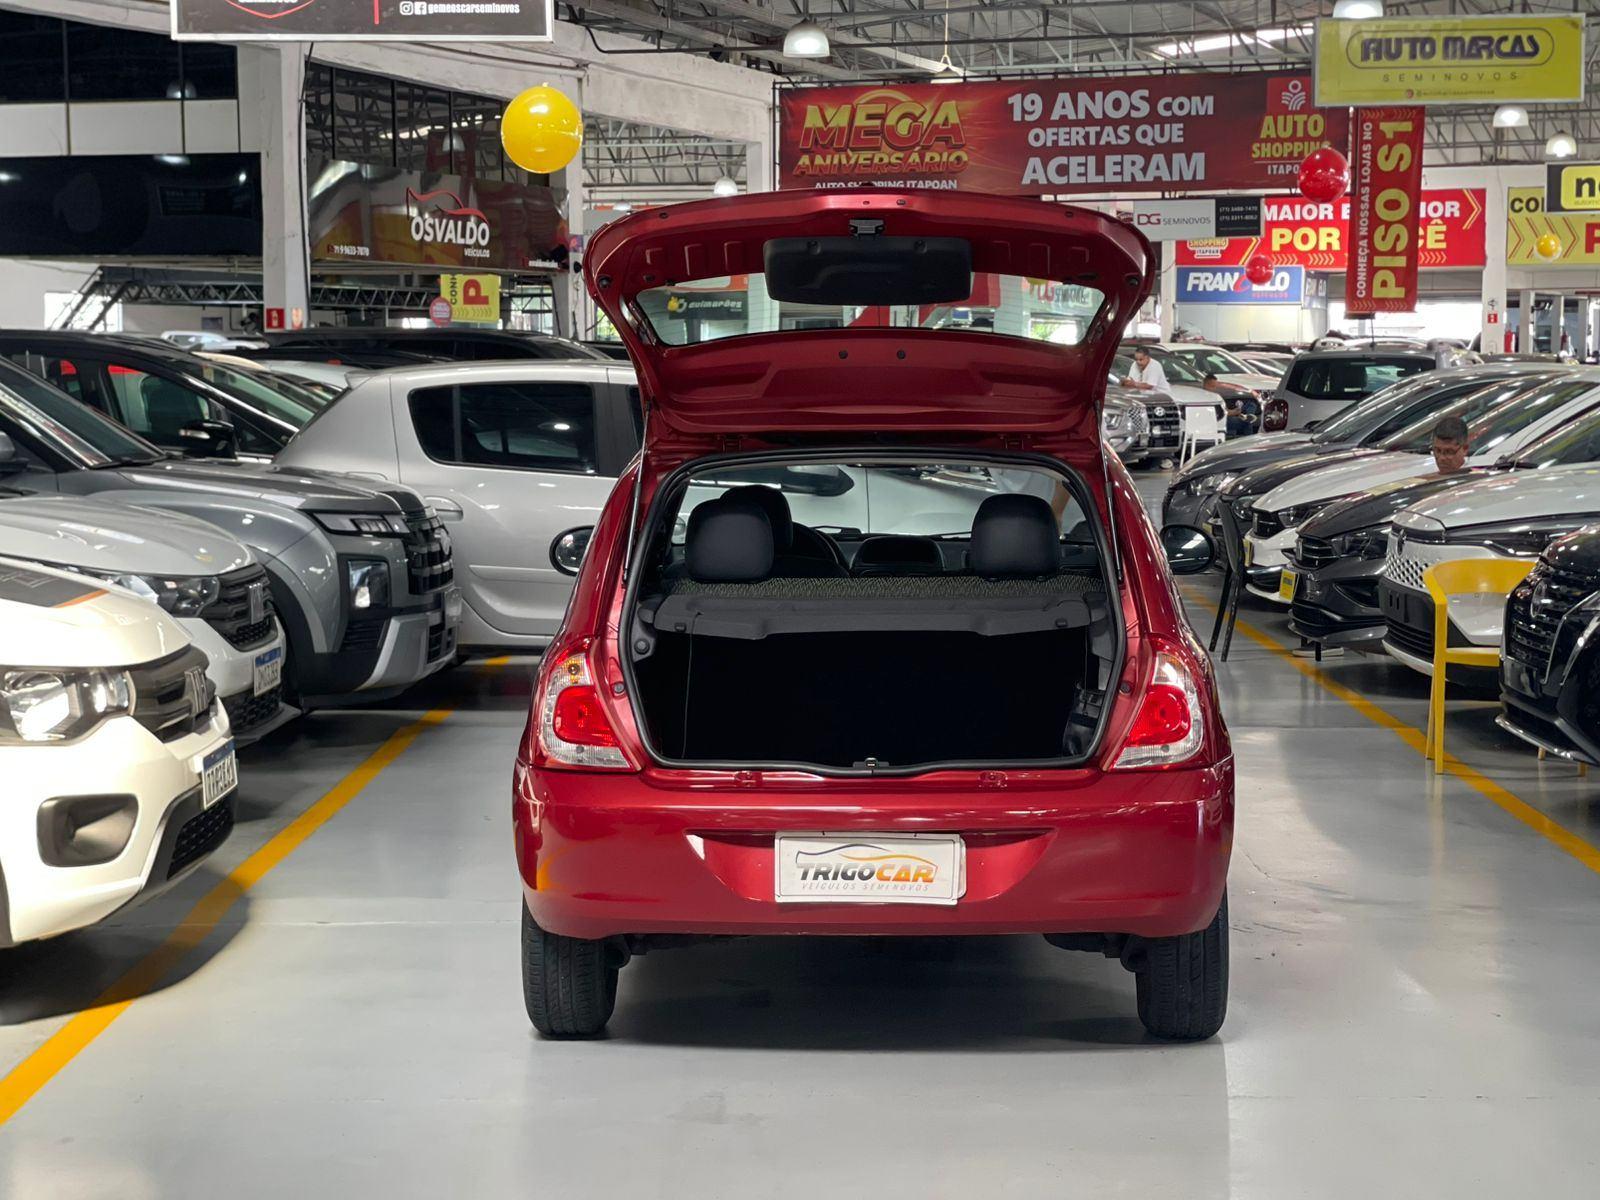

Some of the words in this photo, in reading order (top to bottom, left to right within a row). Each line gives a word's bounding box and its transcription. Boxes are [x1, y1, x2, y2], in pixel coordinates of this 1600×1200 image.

[1361, 37, 1436, 62] AUTO
[1443, 35, 1540, 60] MARCAS
[1008, 94, 1043, 122] 19
[1050, 90, 1150, 121] ANOS
[1157, 96, 1214, 117] COM
[799, 99, 967, 151] MEGA
[1028, 125, 1131, 147] OFERTAS
[1135, 123, 1184, 146] QUE
[1260, 114, 1325, 138] AUTO
[1363, 122, 1373, 140] NO
[1376, 121, 1413, 172] S1
[793, 147, 969, 175] ANIVERSÁRIO
[1021, 152, 1206, 185] ACELERAM
[1267, 164, 1300, 175] ITAPO
[1361, 143, 1373, 183] LOJAS
[906, 180, 958, 189] ITAPOAN
[1264, 203, 1334, 221] MAIOR
[1359, 186, 1370, 236] NOSSAS
[1510, 197, 1545, 213] CO
[410, 216, 490, 246] OSVALDO
[1137, 213, 1161, 225] DG
[1162, 216, 1211, 226] SEMINOVOS
[1272, 226, 1341, 252] POR
[1372, 188, 1410, 298] PISO
[1356, 239, 1370, 298] CONHEÇA
[797, 862, 934, 883] TRIGOCAR
[802, 881, 855, 891] VEÍCULOS
[863, 883, 929, 892] SEMINOVOS
